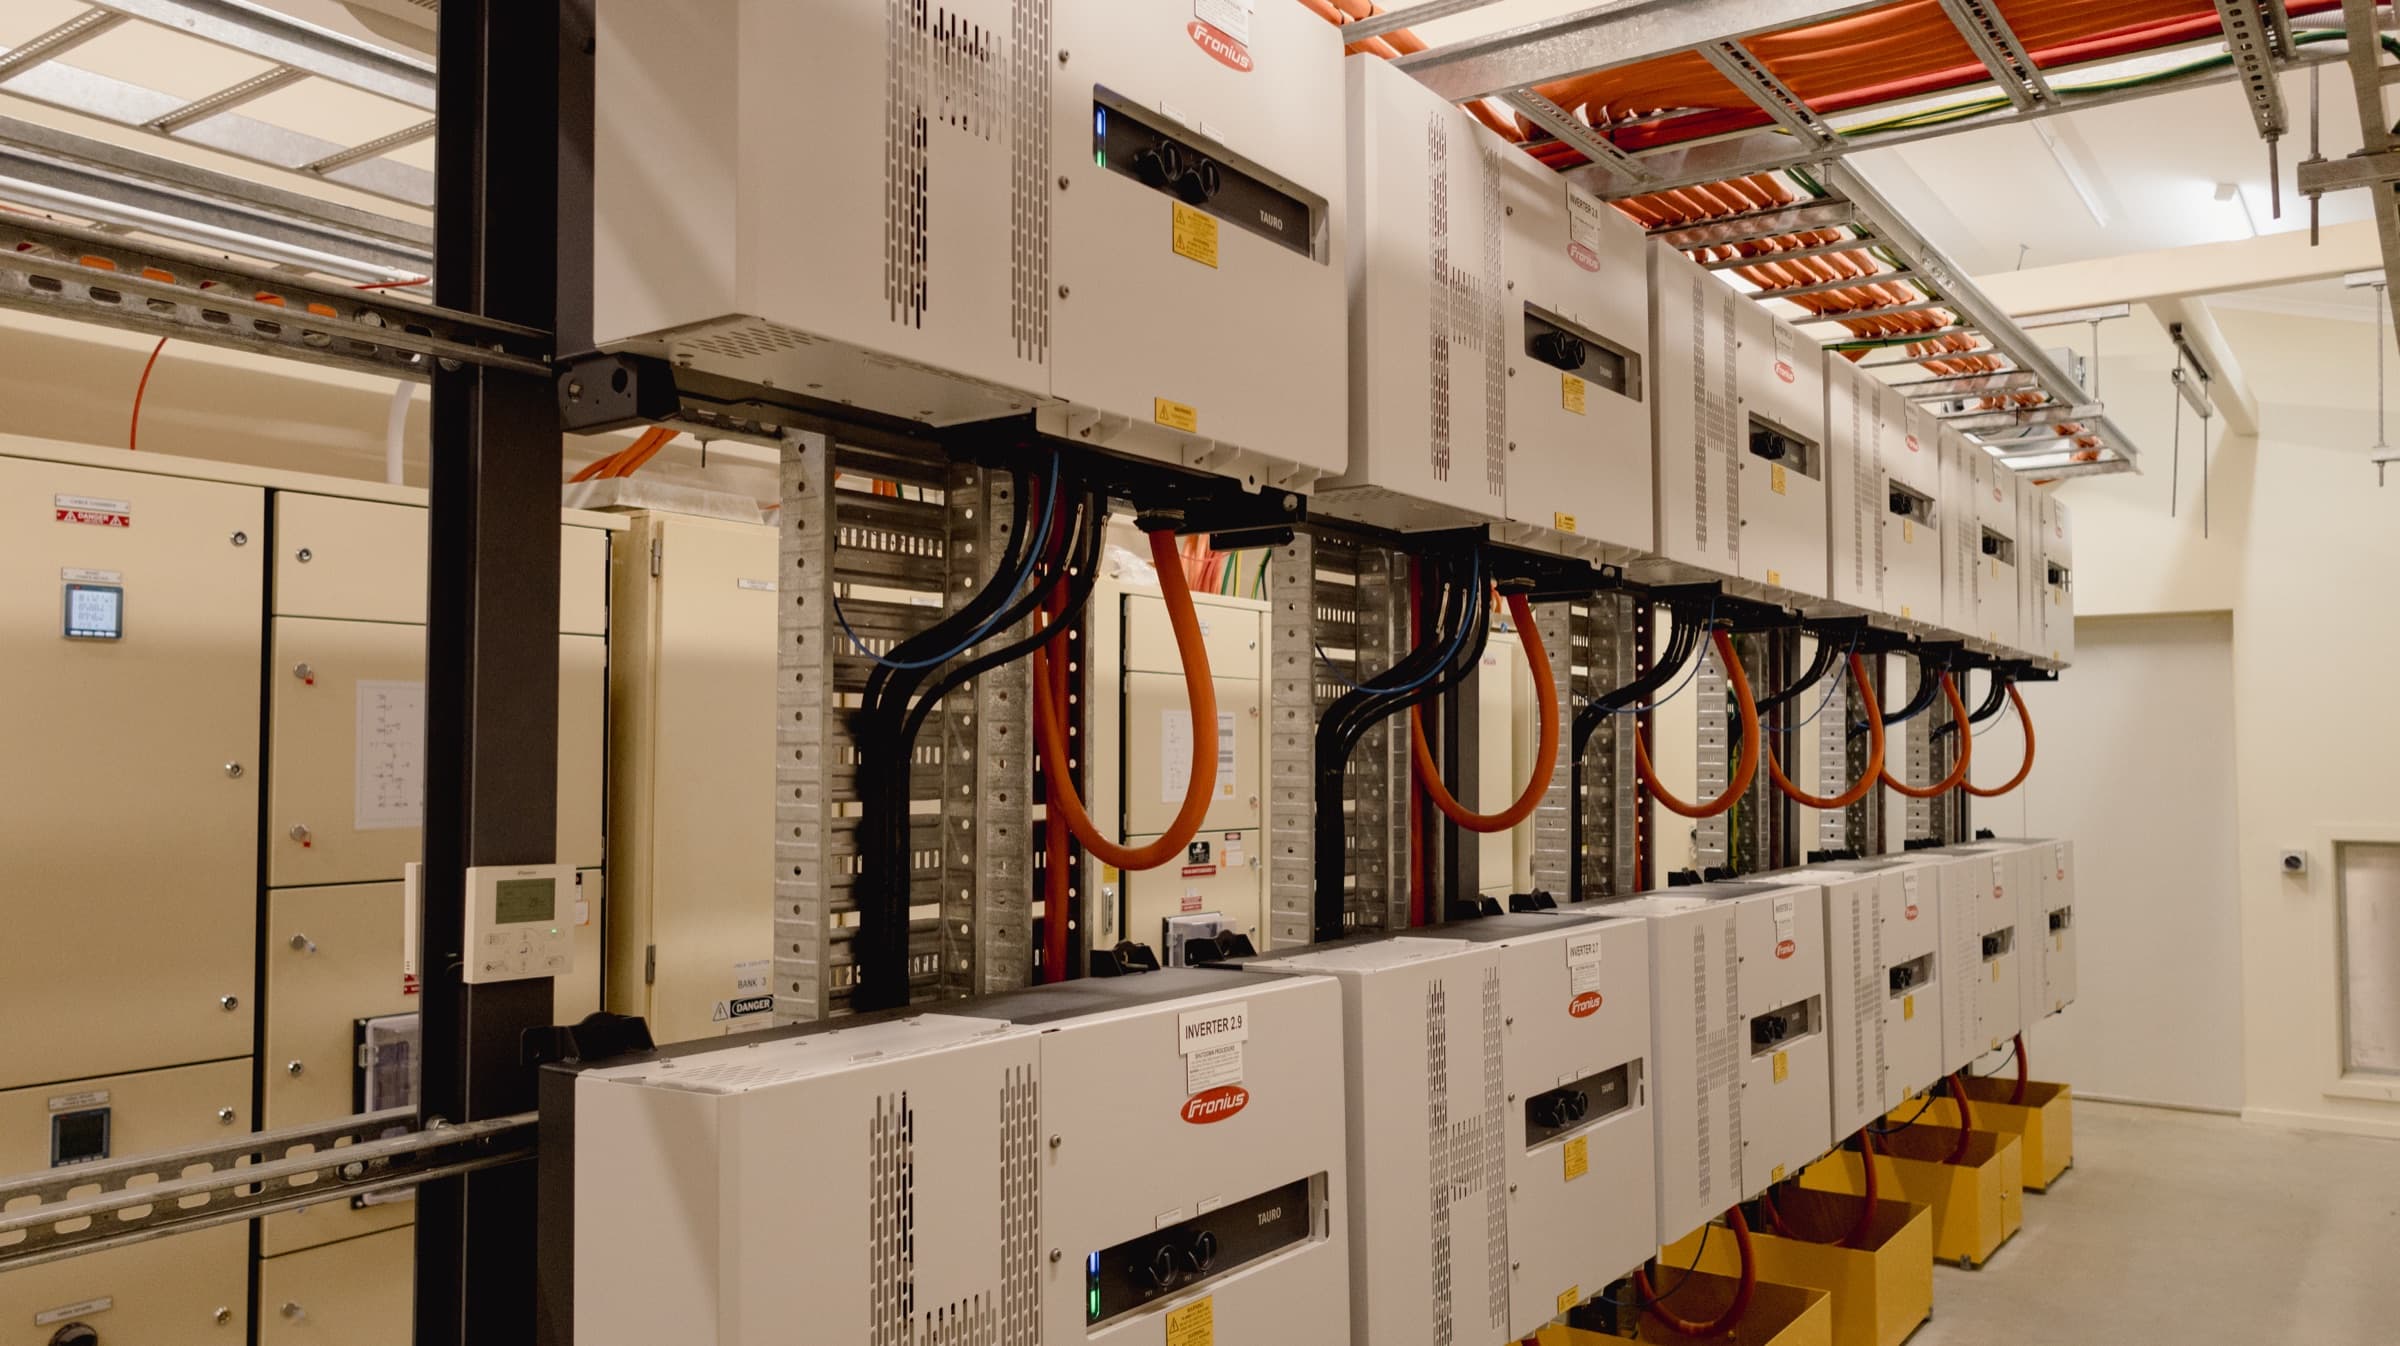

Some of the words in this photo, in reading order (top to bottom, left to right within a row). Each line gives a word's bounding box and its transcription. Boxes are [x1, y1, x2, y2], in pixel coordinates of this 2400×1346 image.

[1193, 24, 1249, 69] Fronius
[1260, 210, 1283, 231] TAURO
[1570, 244, 1599, 269] Fronius
[1570, 944, 1592, 958] INVERTER
[737, 978, 757, 989] BANK
[736, 999, 770, 1013] DANGER
[1571, 997, 1600, 1014] Fronius
[1185, 1017, 1229, 1040] INVERTER
[1230, 1015, 1243, 1031] 2.9
[1188, 1092, 1246, 1119] Fronius
[1258, 1207, 1282, 1226] TAURO
